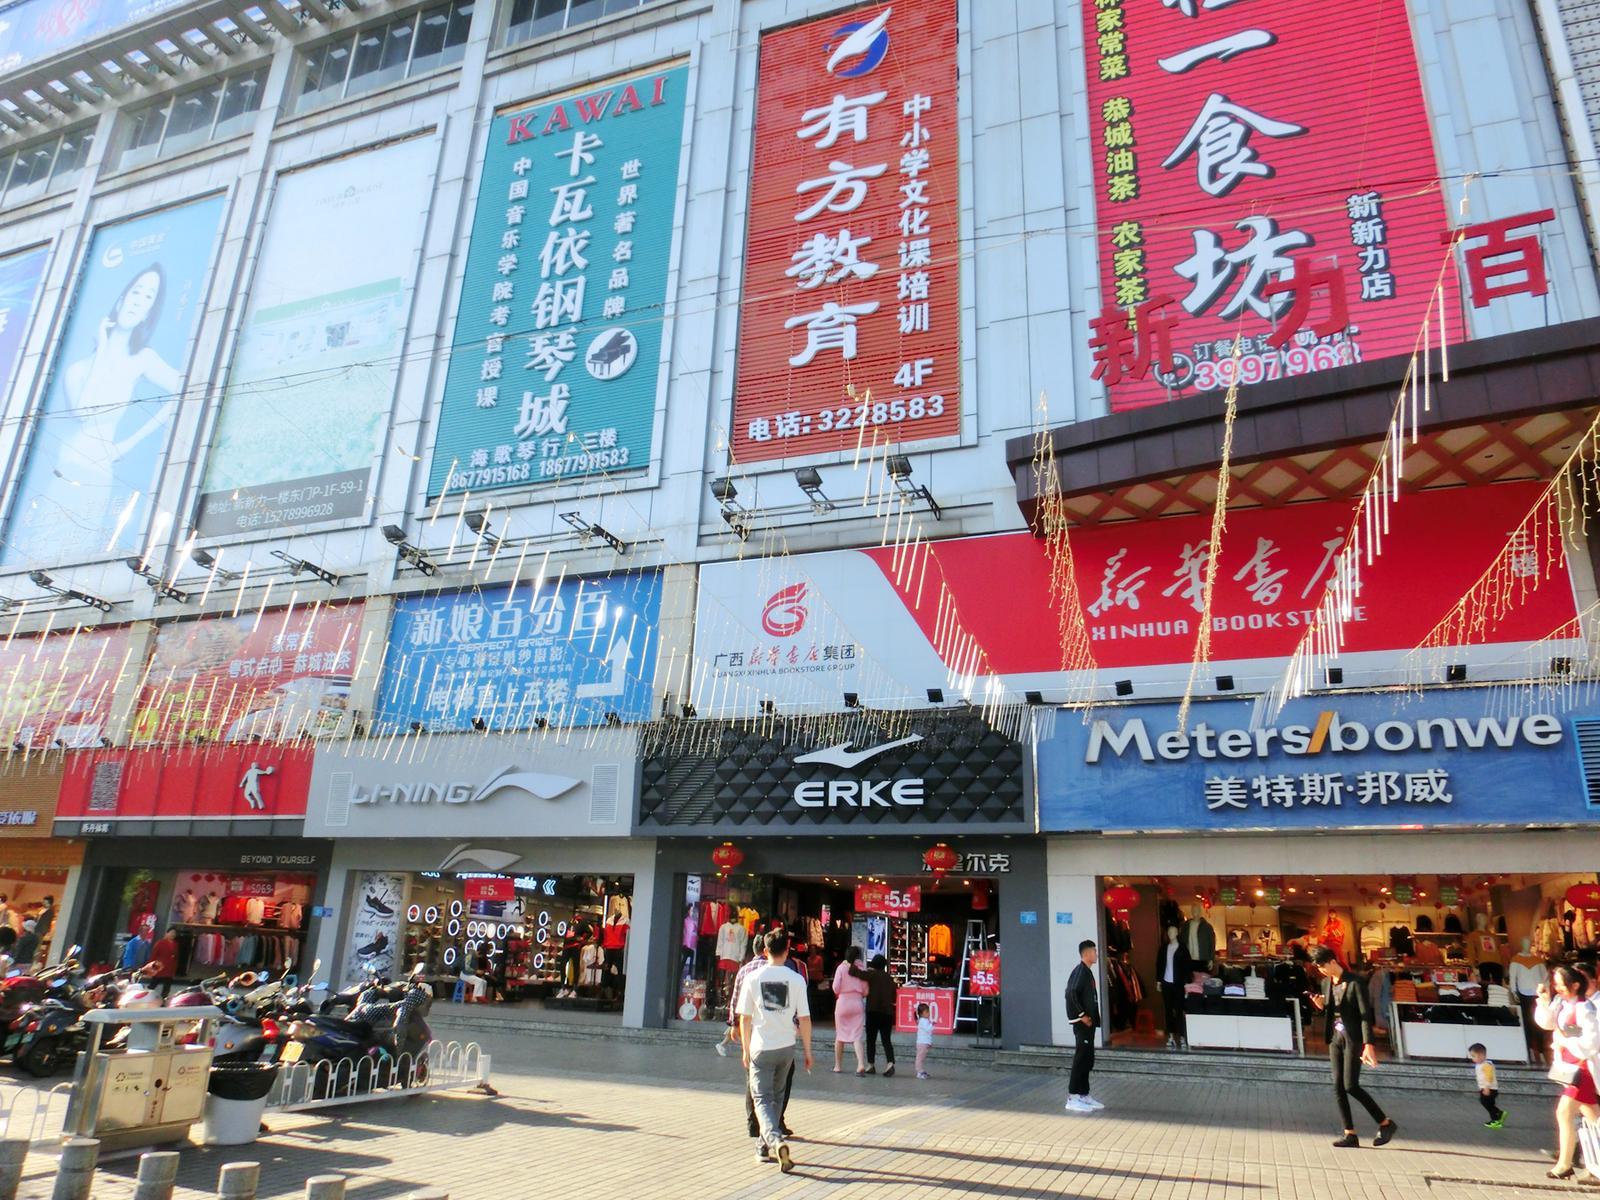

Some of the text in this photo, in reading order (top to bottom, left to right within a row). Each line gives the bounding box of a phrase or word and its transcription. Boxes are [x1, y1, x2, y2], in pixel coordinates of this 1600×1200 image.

[505, 76, 668, 144] KAWAI
[1103, 97, 1137, 201] 恭城油茶
[1157, 0, 1310, 319] 一食坊
[603, 159, 643, 318] 世界著名品牌
[784, 91, 888, 367] 有方教育
[897, 94, 932, 333] 中小学文化课培训
[1347, 192, 1392, 300] 新新力店
[514, 131, 604, 438] 卡瓦依钢琴城
[894, 358, 934, 388] 4F
[470, 427, 618, 468] 海歌琴行 三楼
[447, 463, 530, 490] 8677915168
[1087, 527, 1364, 618] 新华书店
[410, 590, 612, 646] 新娘百分百
[1091, 620, 1189, 641] XINHUA
[714, 644, 856, 668] 广西新华书店集团
[779, 665, 824, 674] BOOKSTORE
[827, 663, 856, 672] GROUP
[1085, 711, 1563, 763] Meters/bonwe
[351, 781, 473, 805] LI-NING
[793, 779, 924, 807] ERKE
[1206, 769, 1454, 809] 美特斯·邦威
[241, 855, 317, 864] BEYOND YOURSELF
